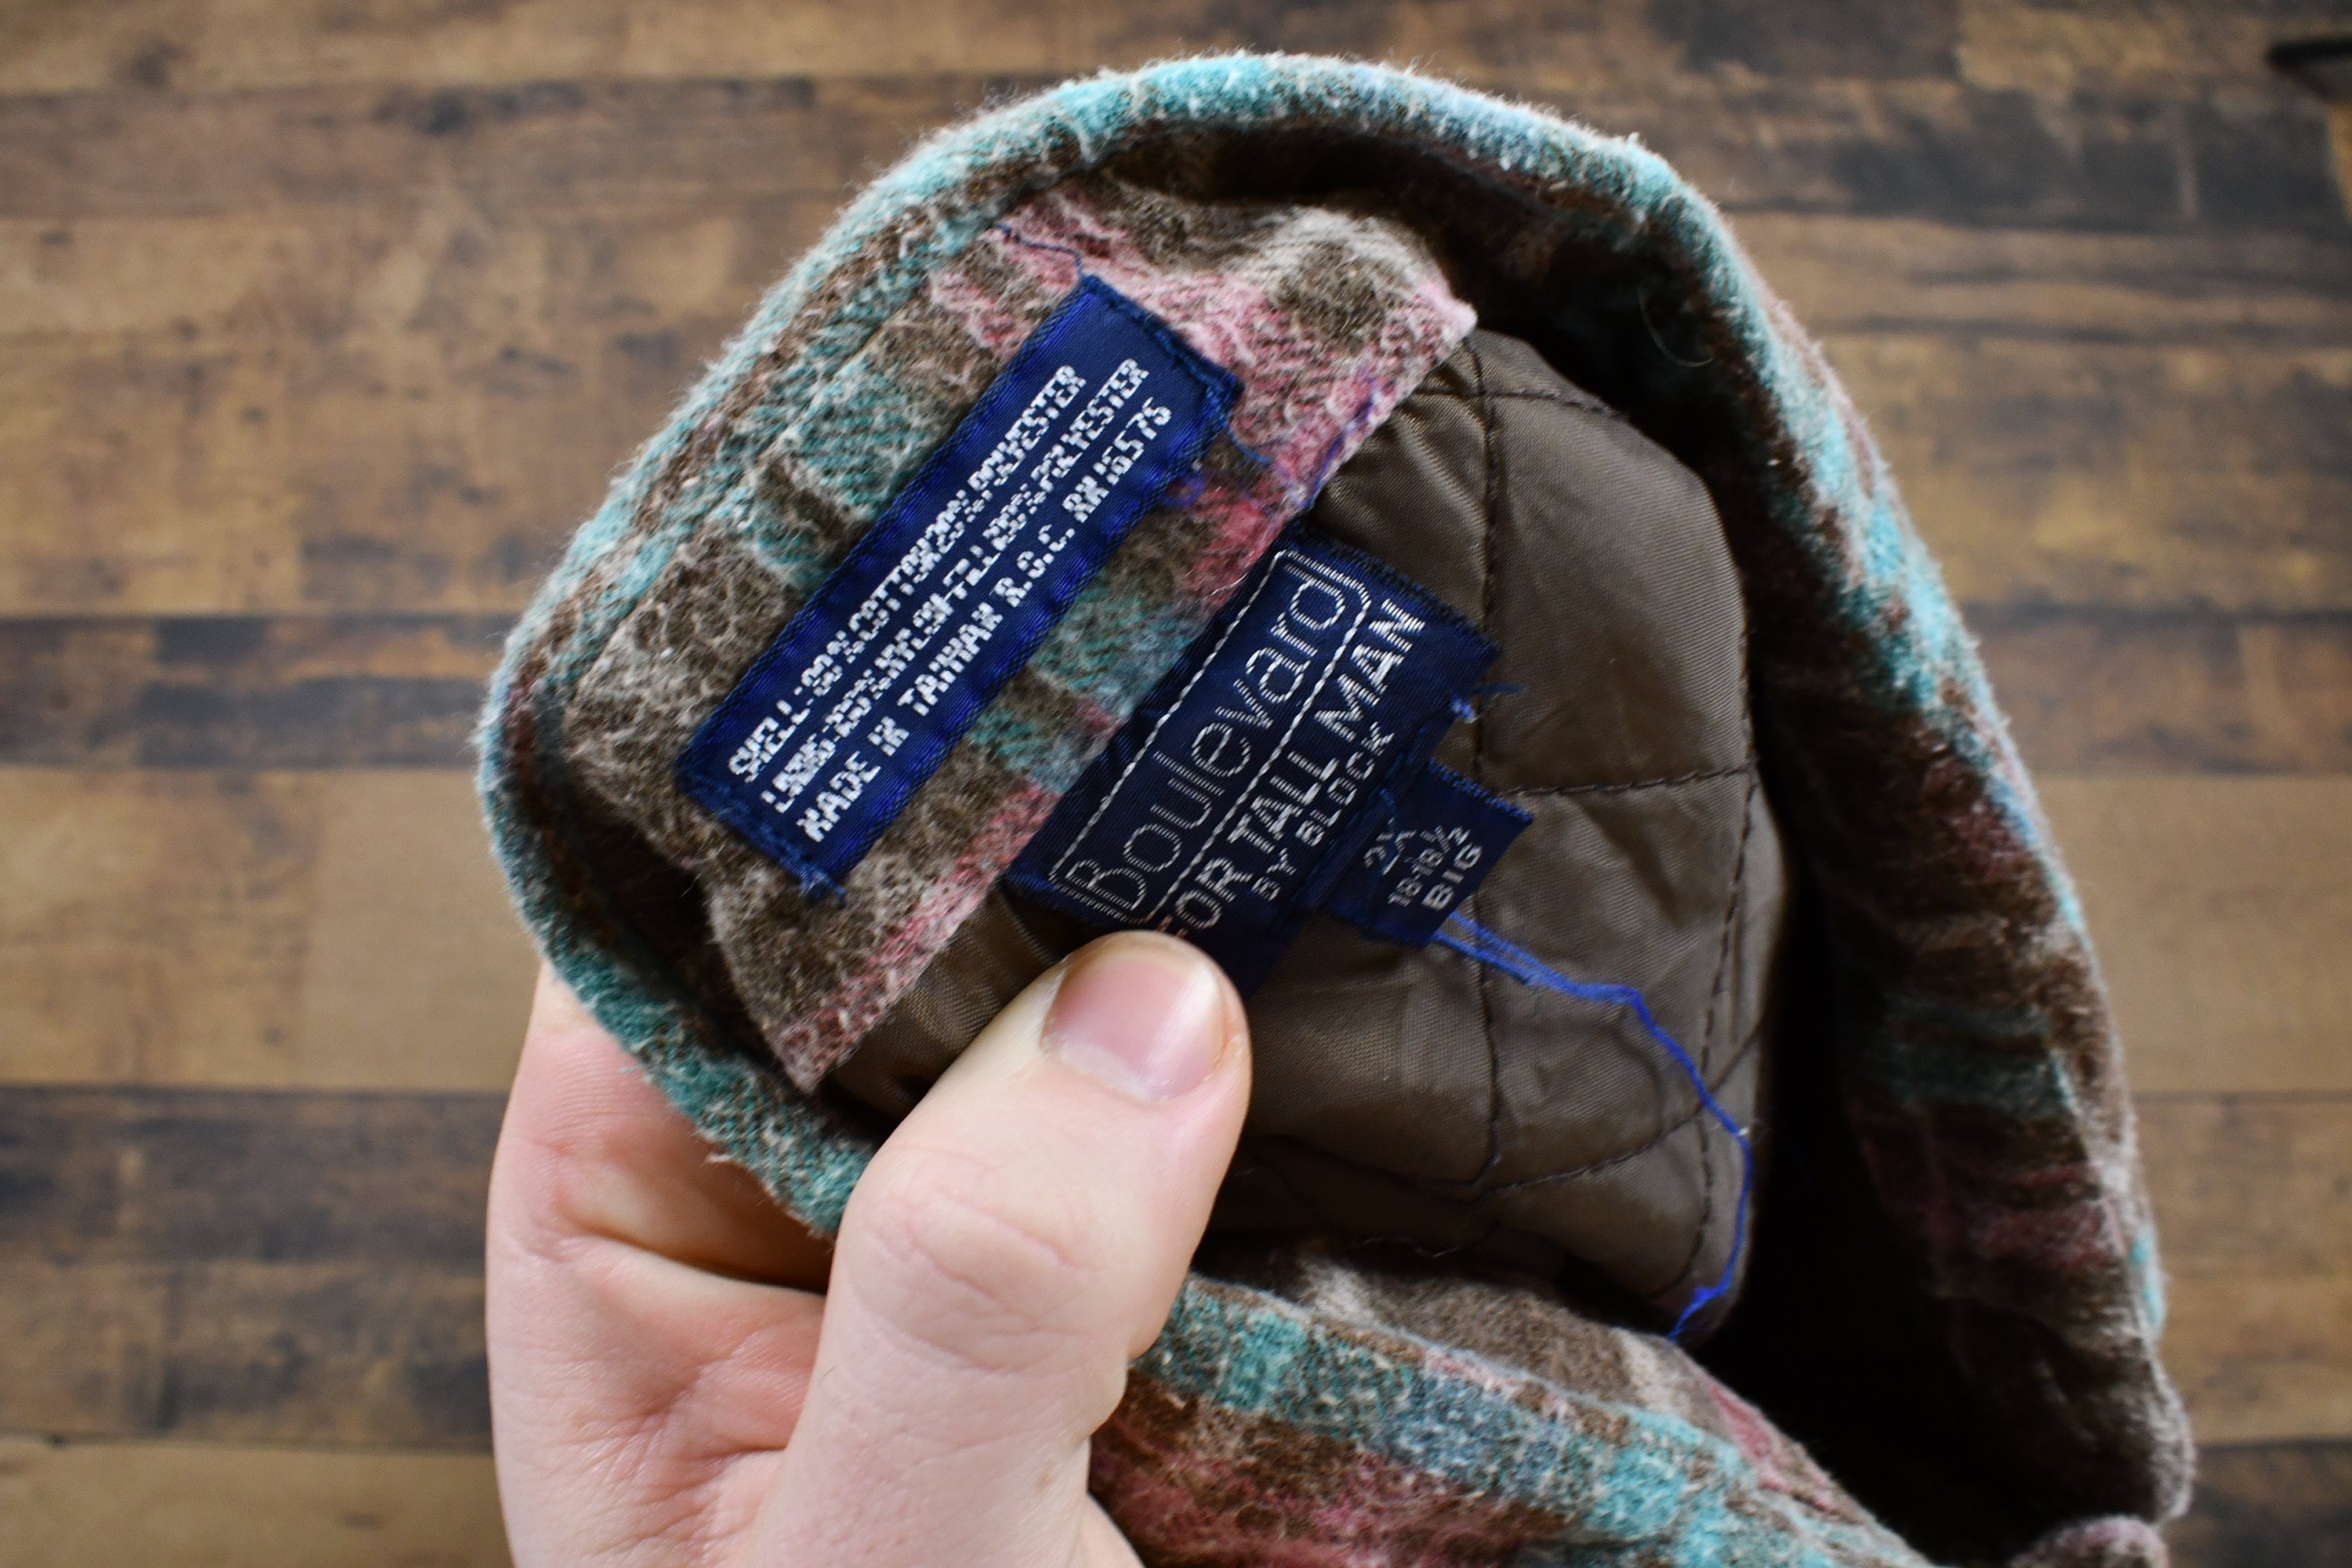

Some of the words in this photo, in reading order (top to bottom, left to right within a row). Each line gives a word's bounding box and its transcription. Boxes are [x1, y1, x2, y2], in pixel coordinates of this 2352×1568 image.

[796, 751, 880, 842] MADE
[868, 717, 909, 757] IN
[897, 602, 1004, 717] TAIWAN
[1065, 564, 1345, 912] Boulevard
[1227, 750, 1339, 853] TALL
[1315, 598, 1426, 742] MAN
[1250, 848, 1297, 902] BY
[1296, 721, 1396, 847] BLOCK
[1421, 843, 1483, 911] BIG
